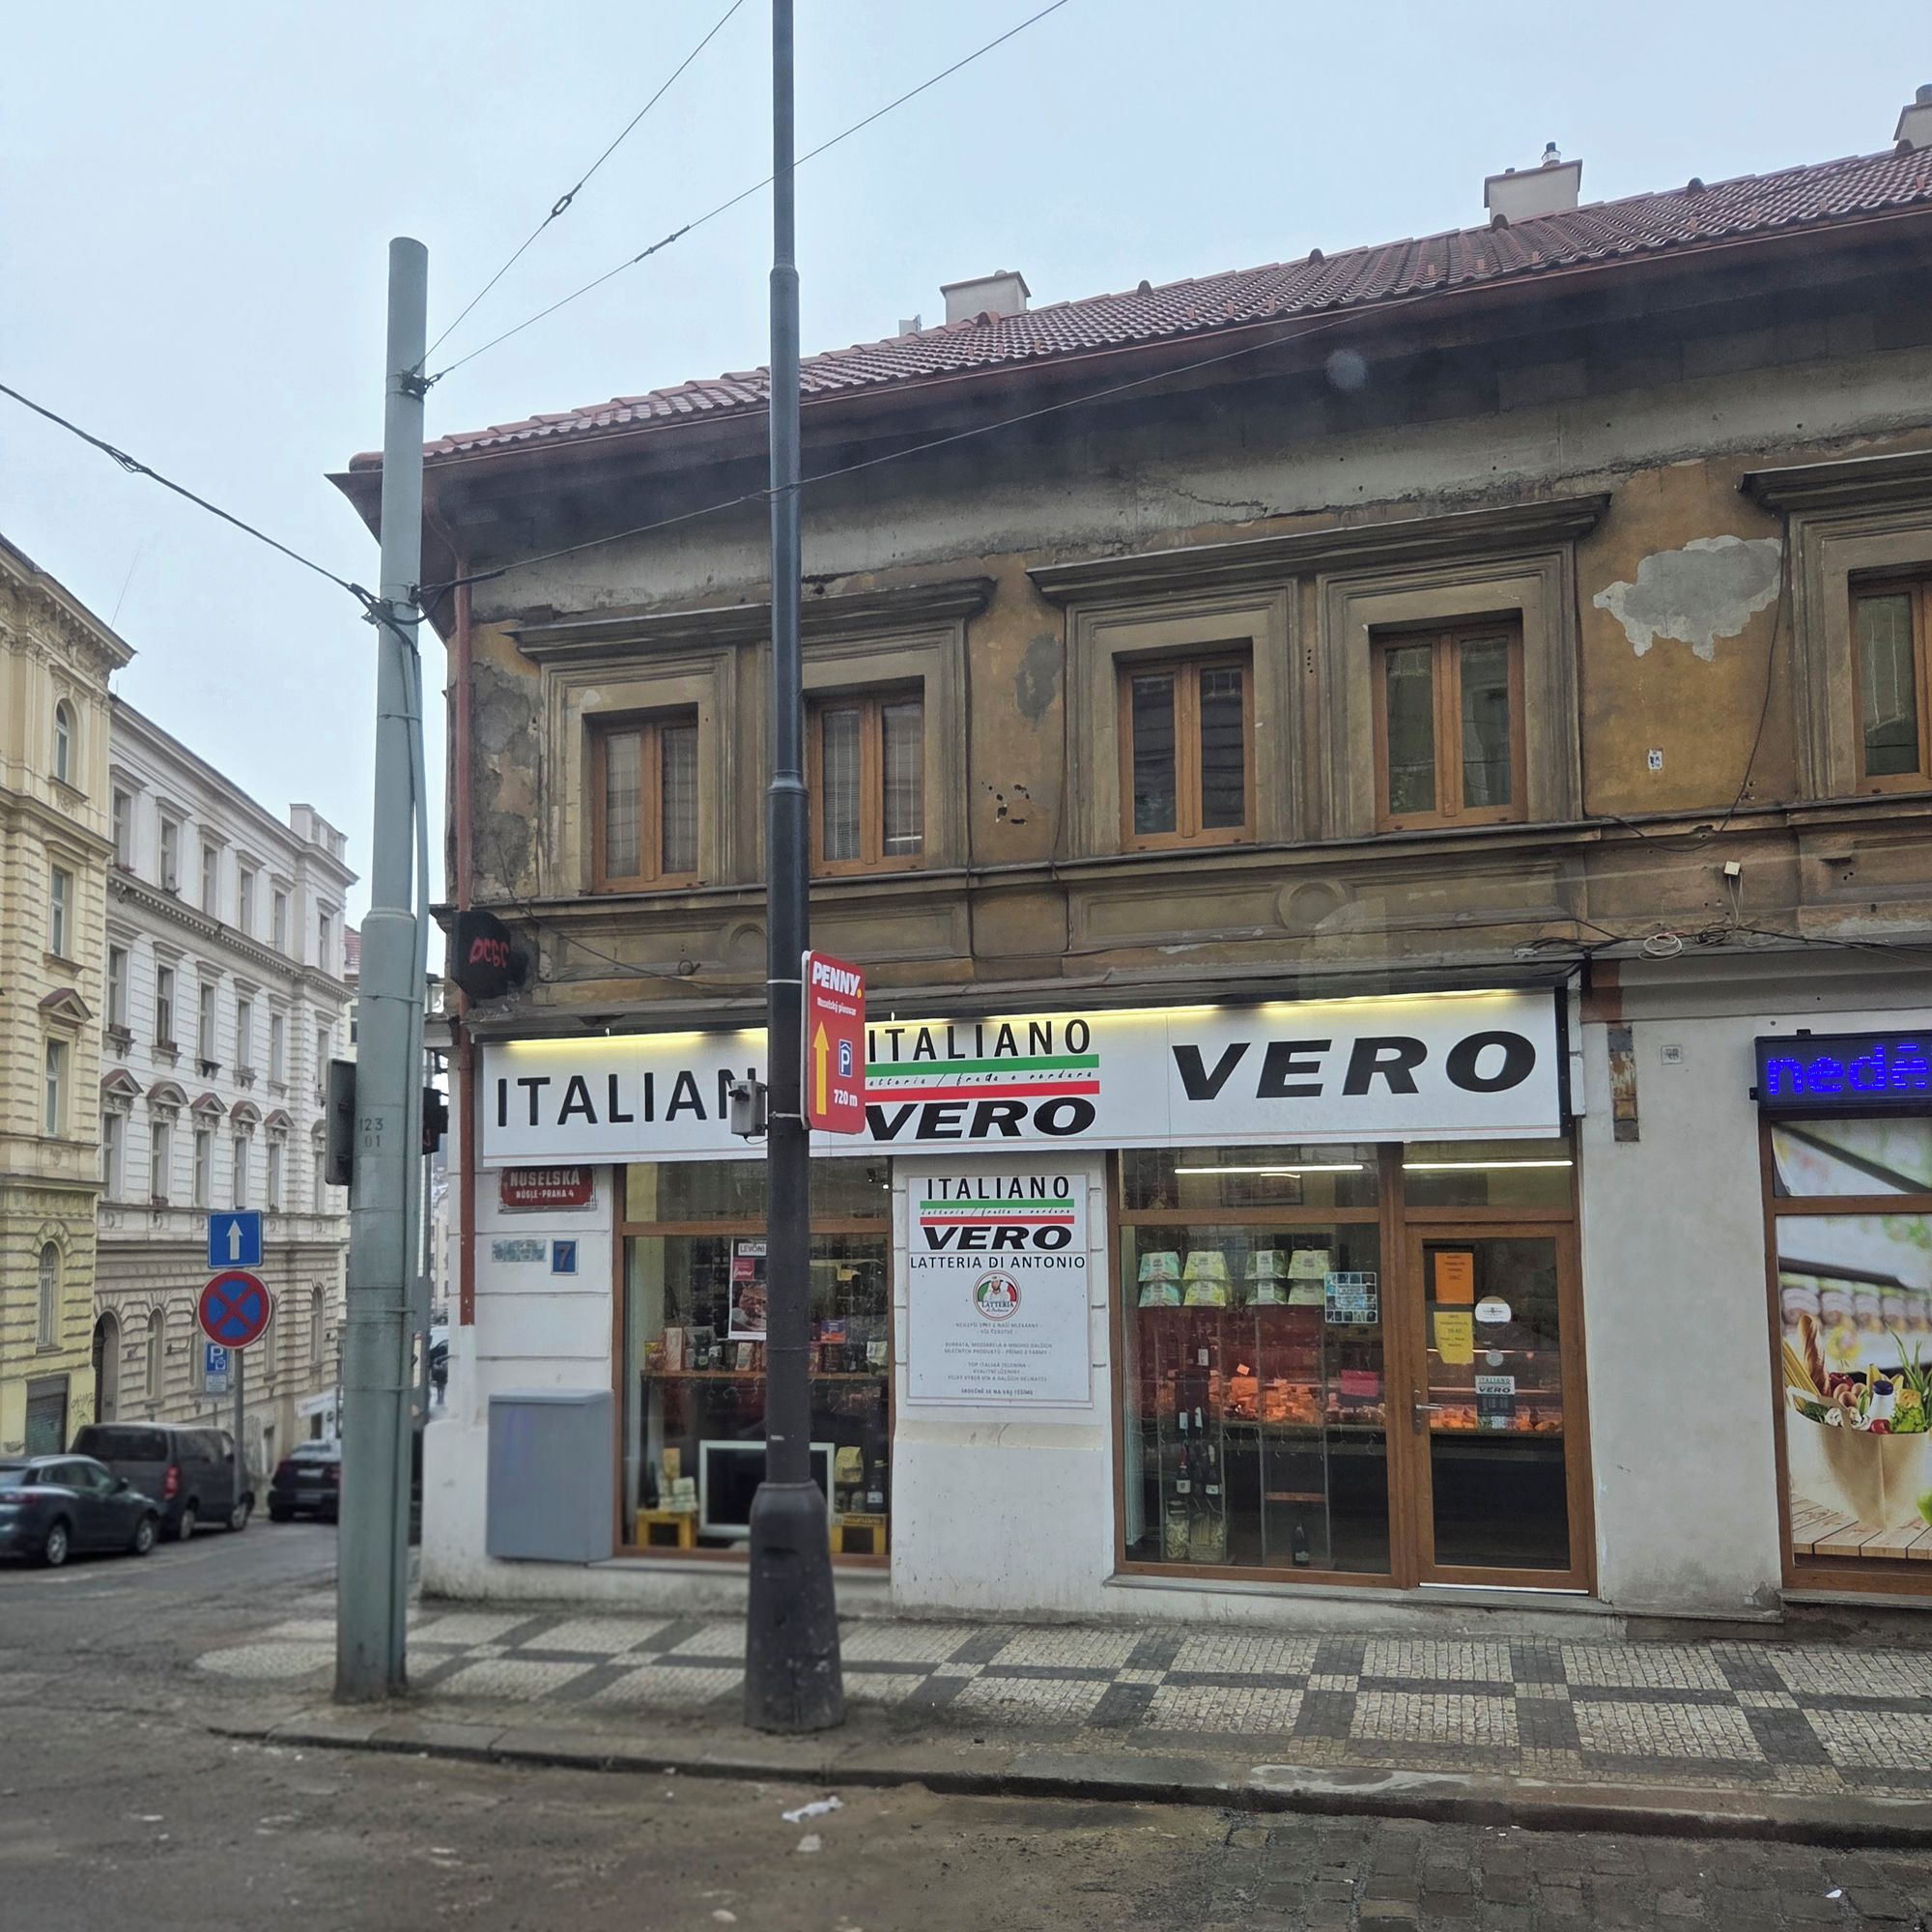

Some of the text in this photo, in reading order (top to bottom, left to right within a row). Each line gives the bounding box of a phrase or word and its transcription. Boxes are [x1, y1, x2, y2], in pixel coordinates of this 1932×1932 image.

[868, 1018, 1091, 1063] ITALIANO
[1172, 1030, 1537, 1101] VERO
[834, 1089, 858, 1107] 720 m
[360, 1118, 384, 1131] 123
[866, 1096, 1096, 1141] VERO
[510, 1168, 581, 1187] NUSELSKÁ
[927, 1176, 1069, 1200] ITALIANO
[923, 1225, 1072, 1251] VERO
[556, 1244, 571, 1269] 7
[910, 1256, 1085, 1269] LATTERIA DI ANTONIO
[210, 1345, 224, 1364] P
